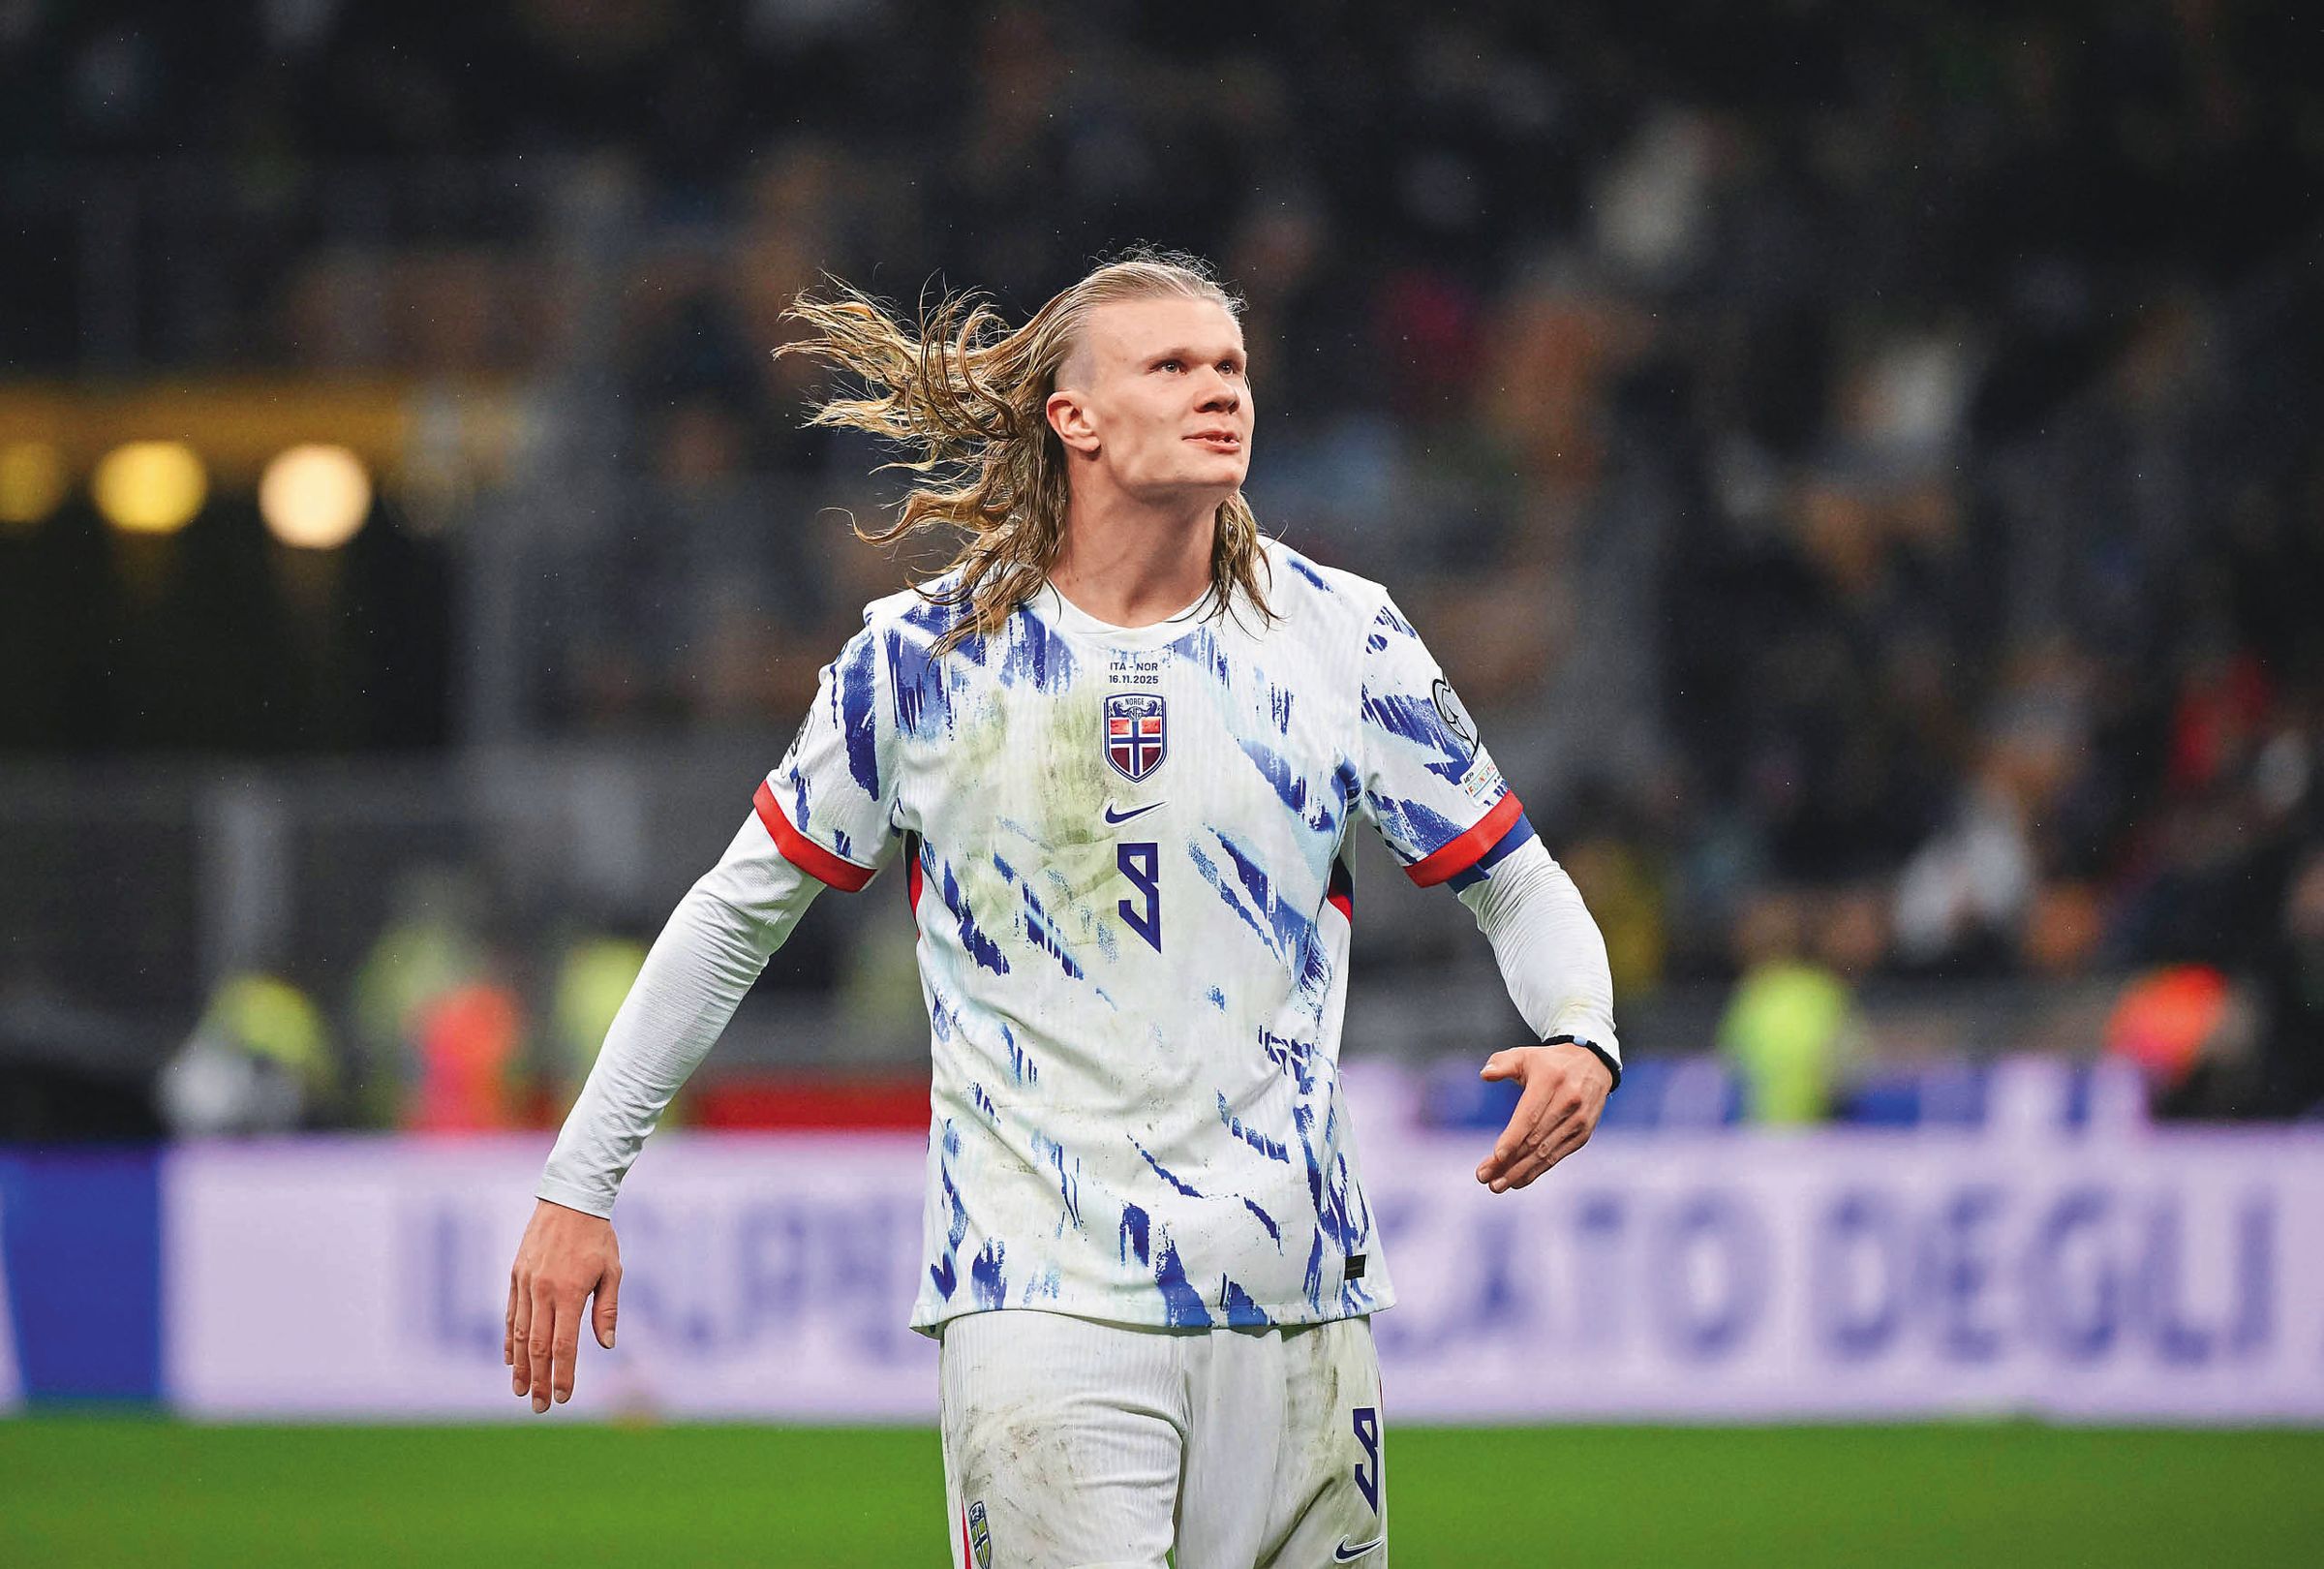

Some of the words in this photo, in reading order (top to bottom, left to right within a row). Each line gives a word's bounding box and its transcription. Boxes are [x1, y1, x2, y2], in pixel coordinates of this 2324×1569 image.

[1109, 674, 1159, 684] 16.11.2025
[1110, 661, 1126, 671] ITA
[1136, 662, 1158, 671] NOR
[1116, 842, 1162, 954] 9
[1352, 1407, 1379, 1518] 9
